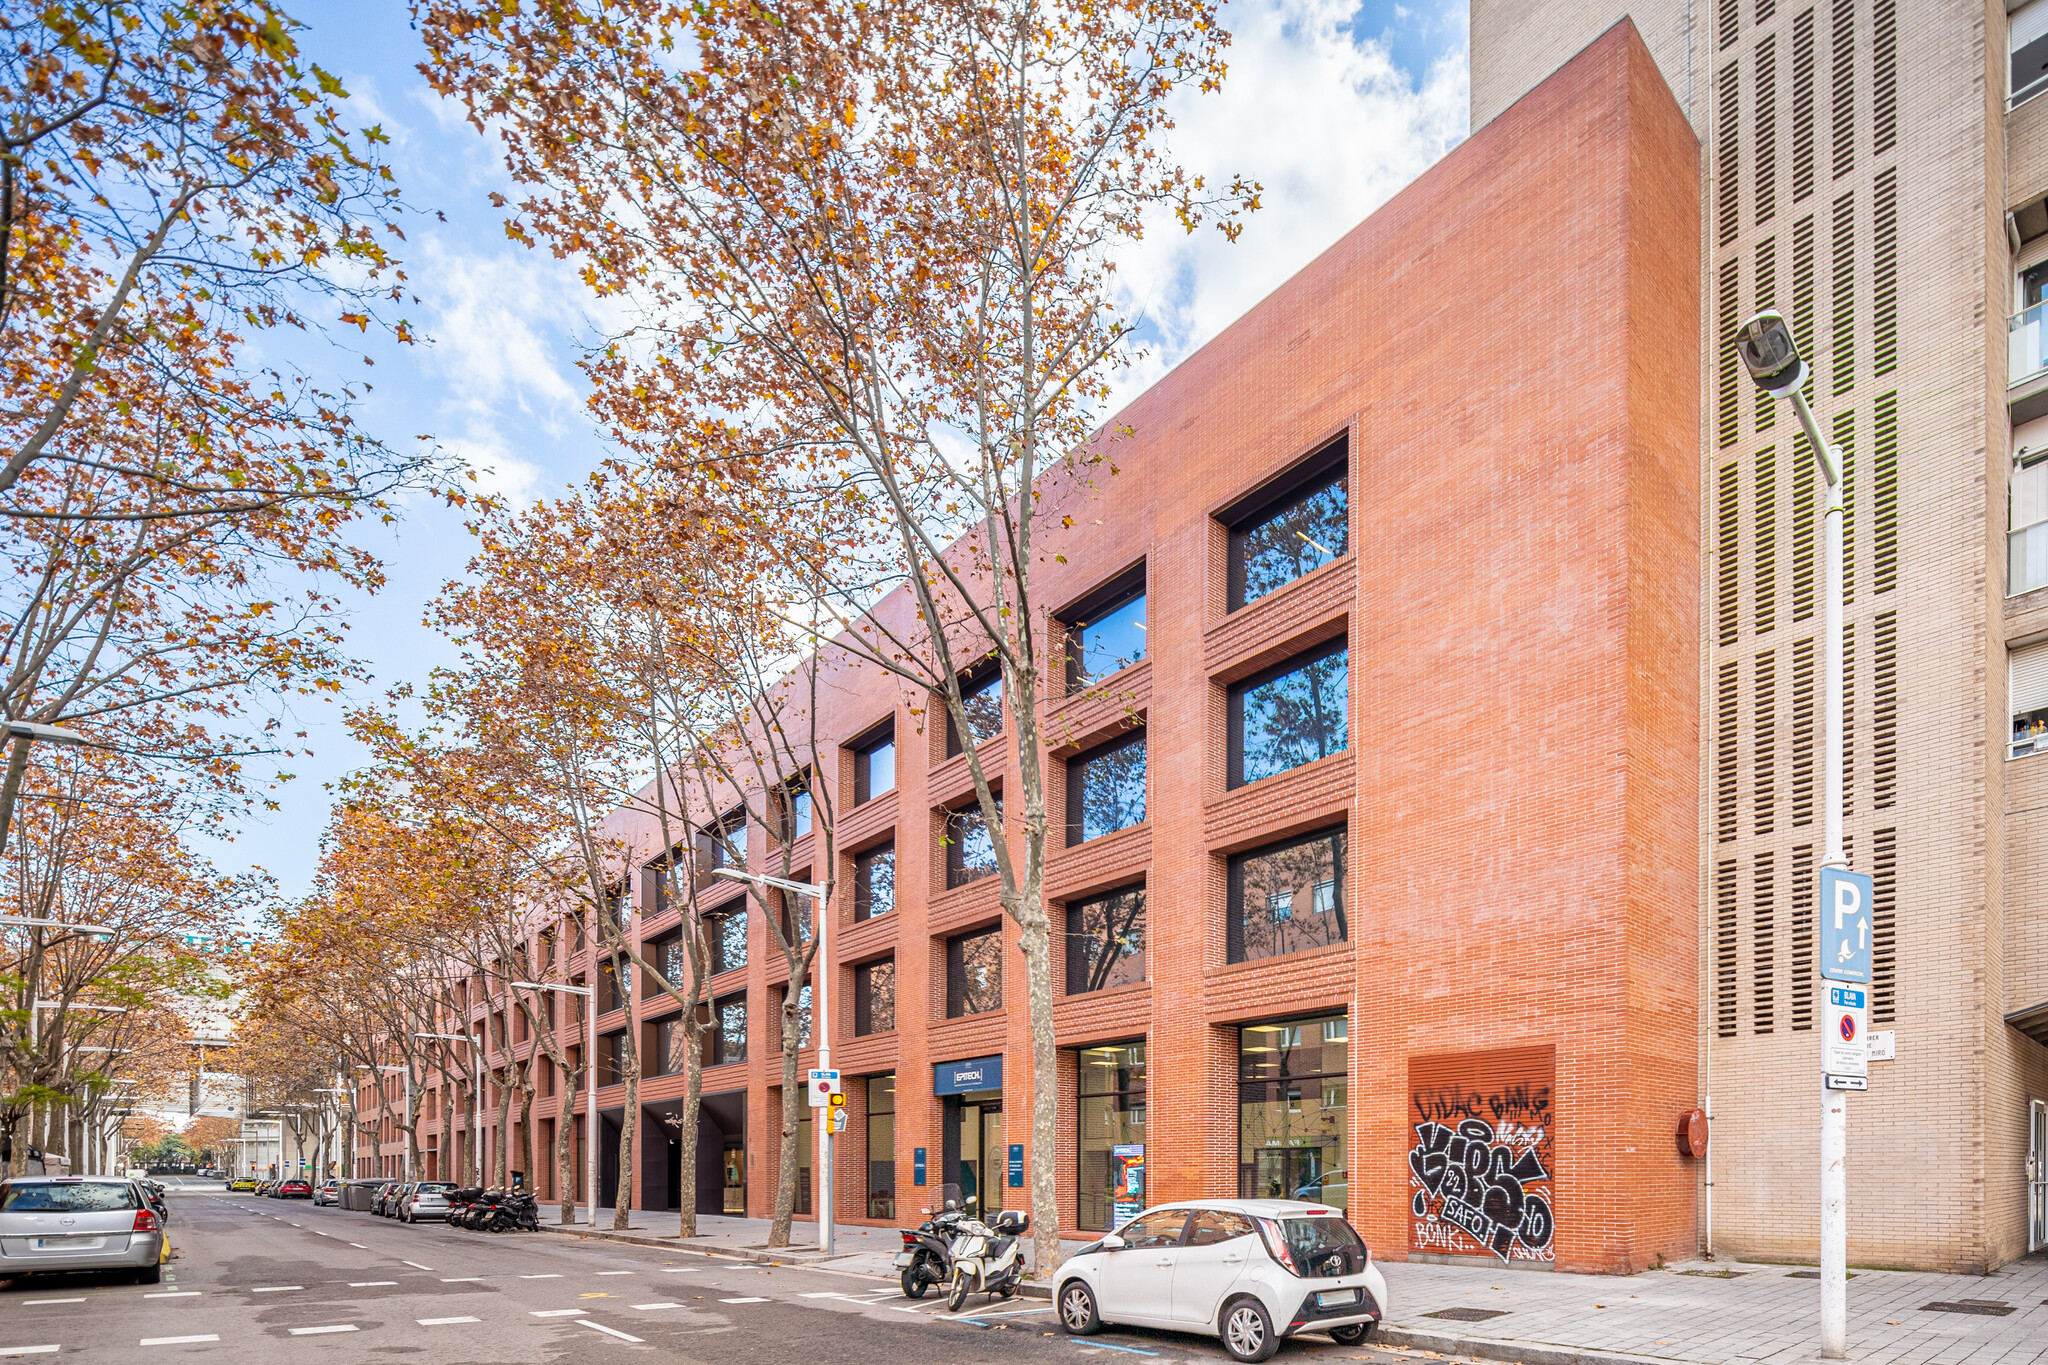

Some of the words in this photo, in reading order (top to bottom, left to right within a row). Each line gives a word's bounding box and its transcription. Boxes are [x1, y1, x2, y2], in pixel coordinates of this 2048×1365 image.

[1834, 879, 1862, 930] P
[1843, 991, 1857, 1001] BLAVA
[1445, 1169, 1462, 1192] 22
